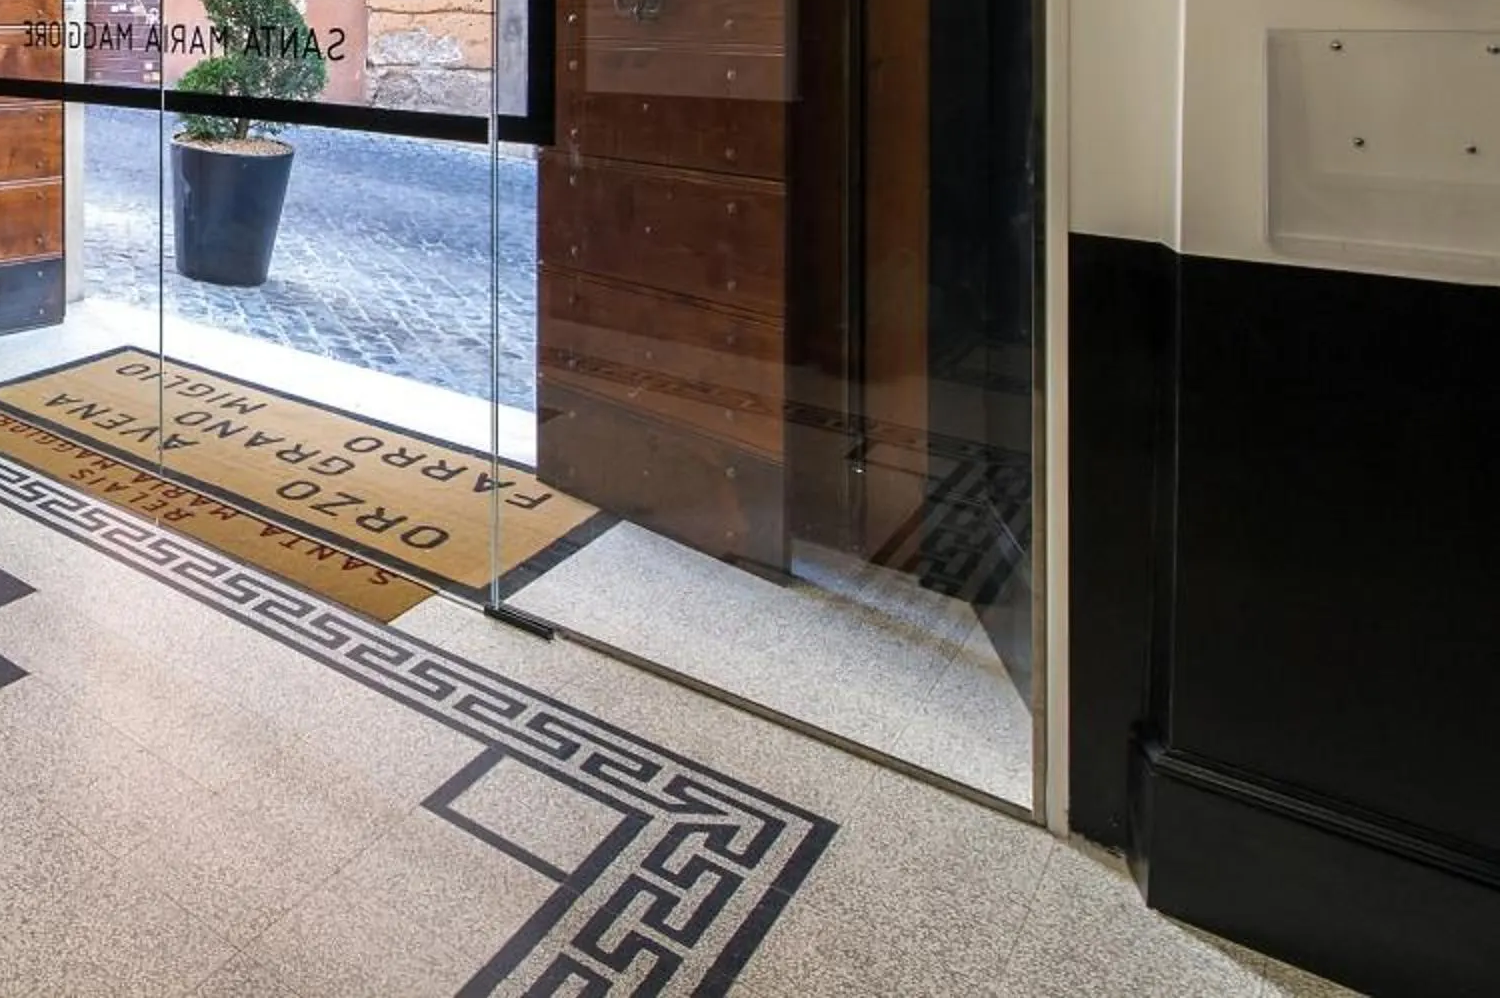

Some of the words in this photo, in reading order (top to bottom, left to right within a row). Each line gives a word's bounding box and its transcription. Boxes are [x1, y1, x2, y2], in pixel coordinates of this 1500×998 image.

[115, 363, 269, 415] MIGLIO
[44, 393, 200, 452] AVENA
[174, 410, 356, 476] GRANO
[68, 468, 196, 522] RELAIS
[131, 471, 241, 521] MARIA
[343, 436, 554, 510] FARRO
[275, 479, 450, 550] ORZO
[259, 523, 398, 586] SANTA
